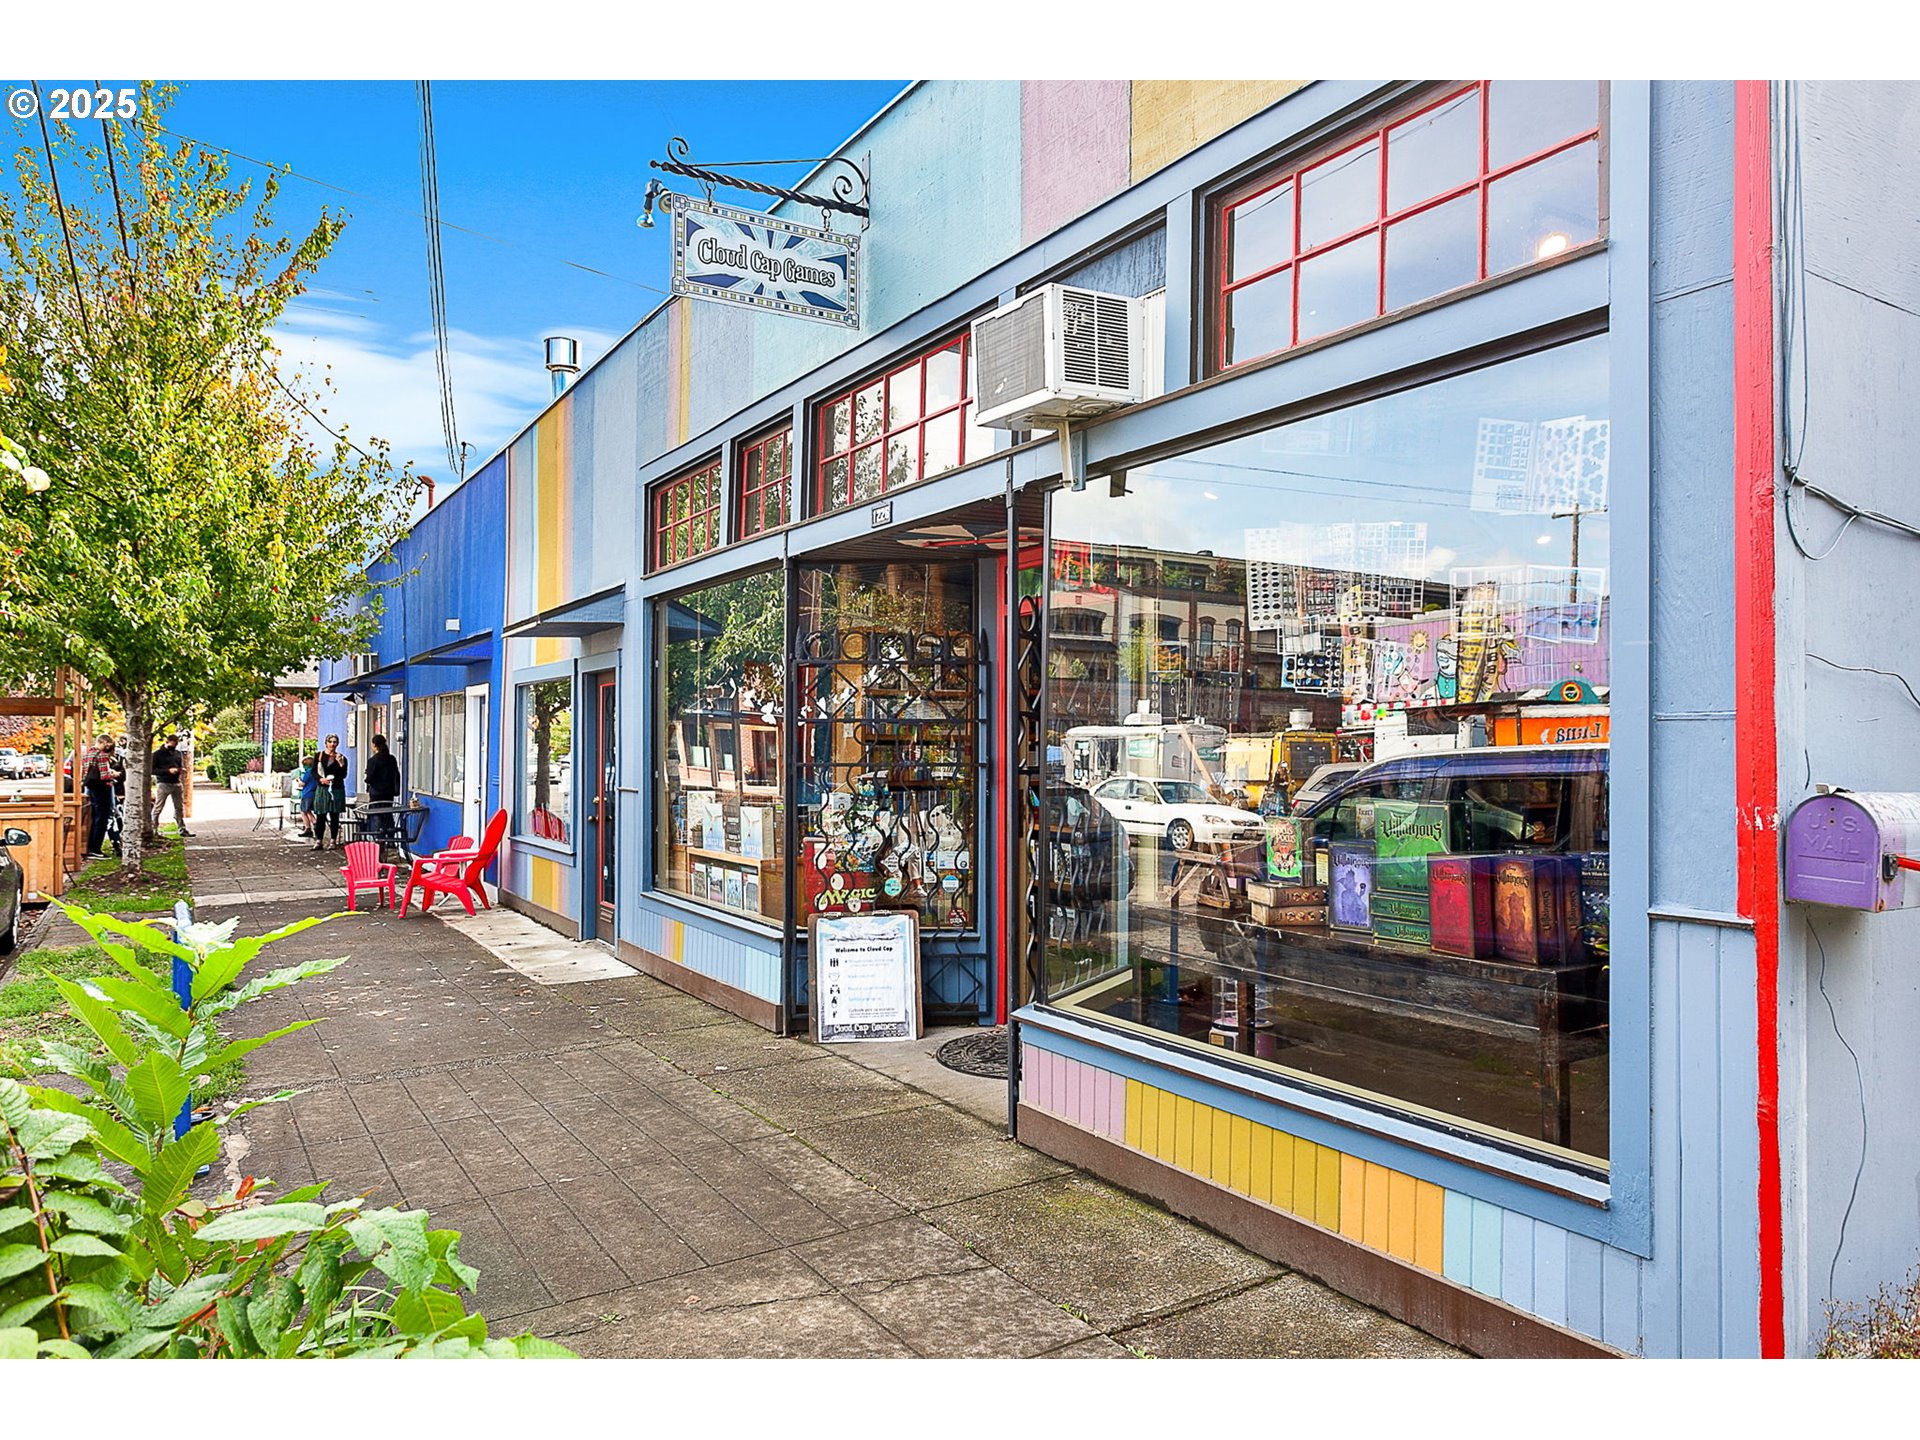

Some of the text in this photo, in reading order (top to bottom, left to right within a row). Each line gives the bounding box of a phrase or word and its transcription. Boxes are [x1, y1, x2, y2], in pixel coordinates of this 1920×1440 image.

[697, 237, 836, 287] Cloud Cap Games
[1803, 832, 1860, 855] MAIL
